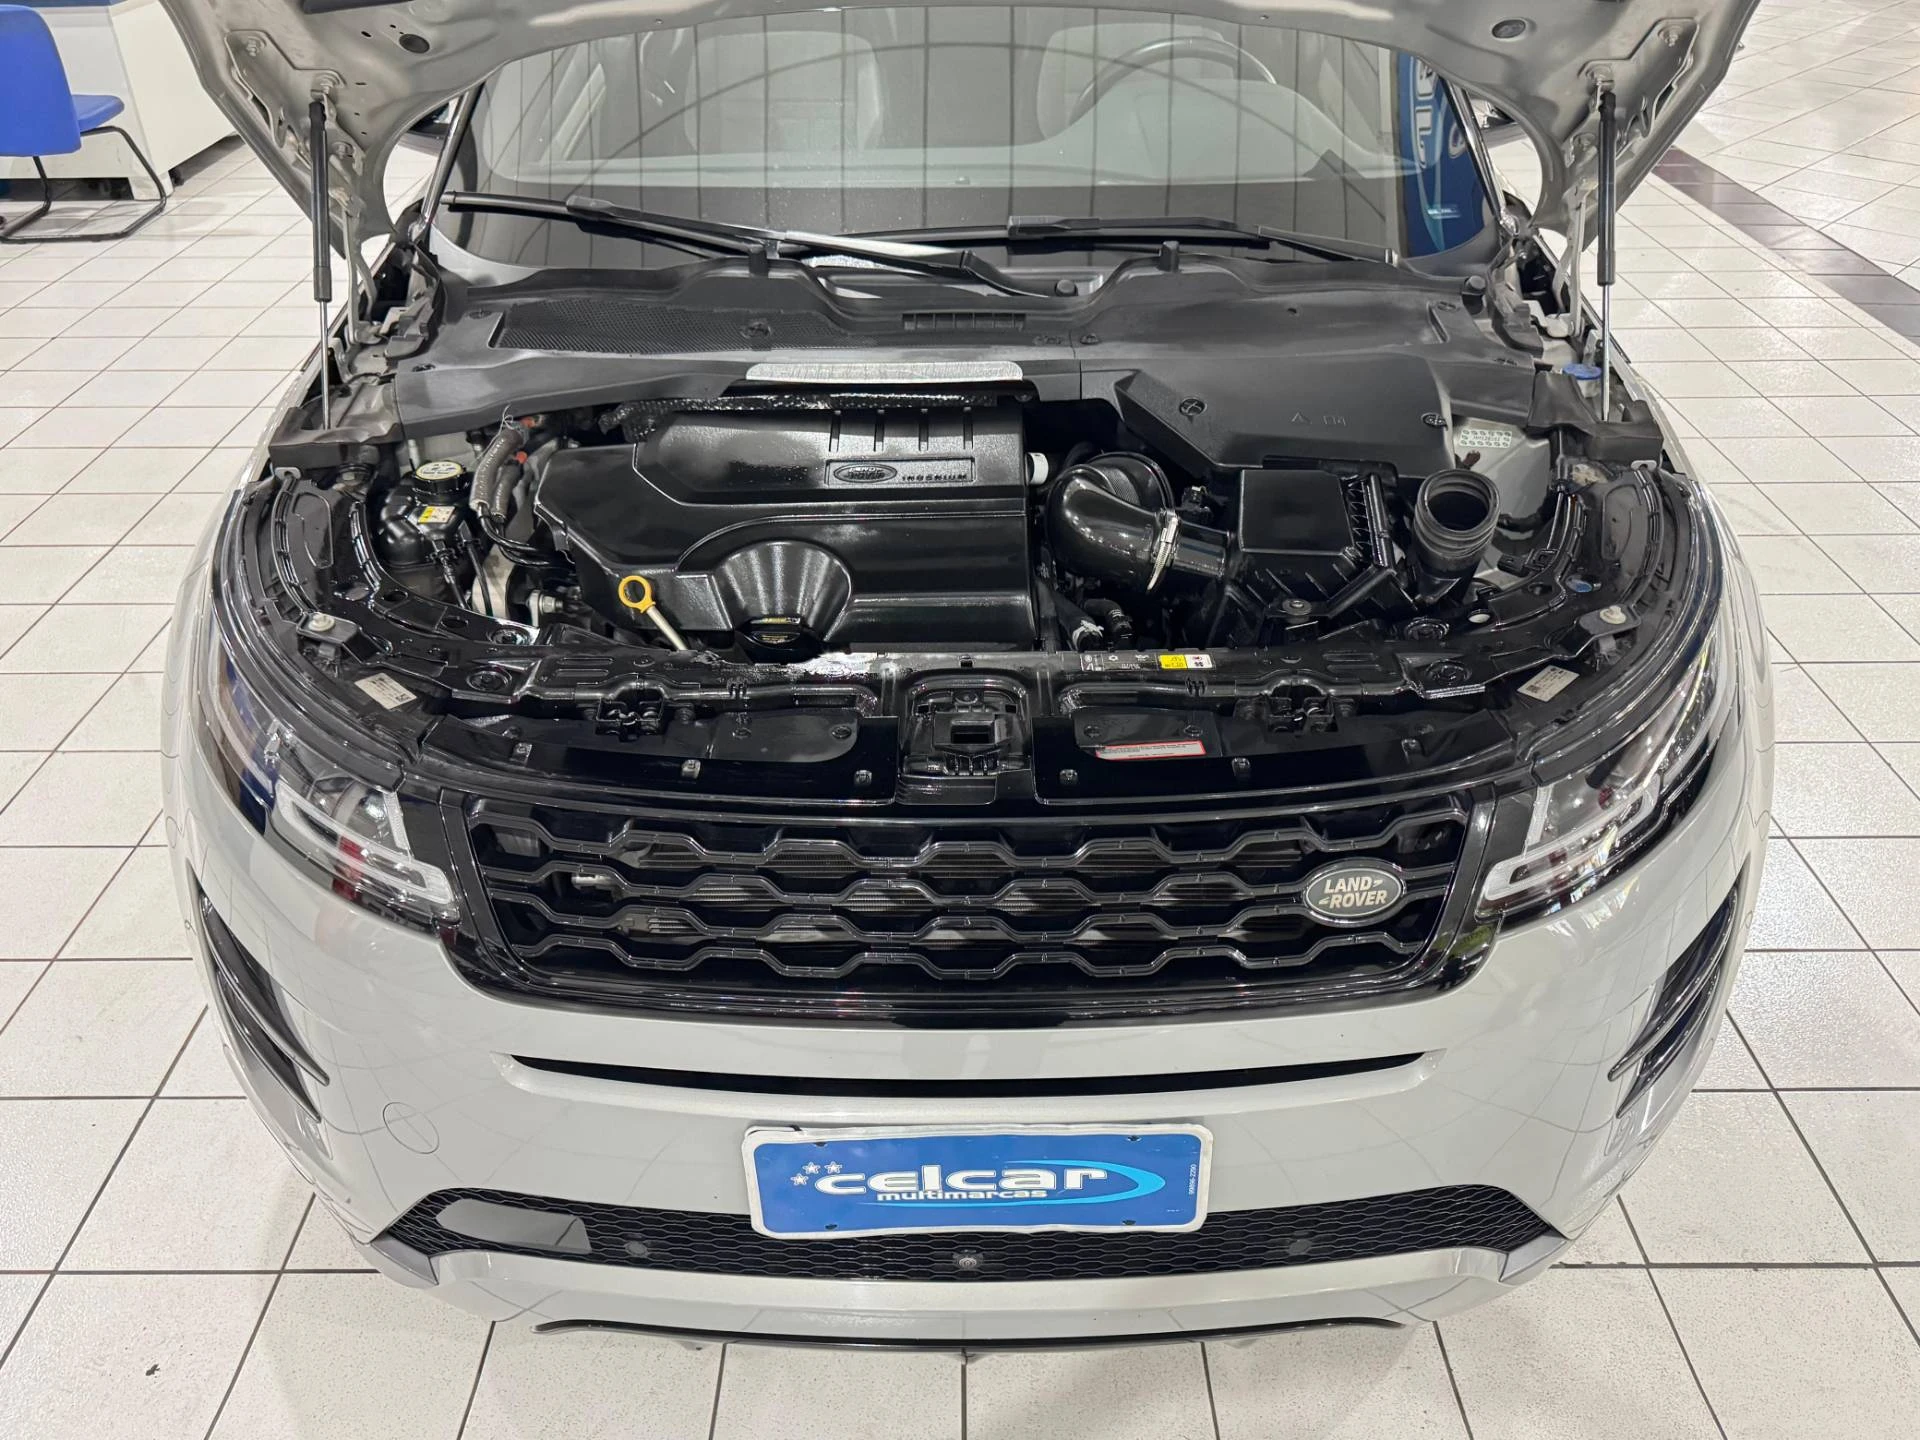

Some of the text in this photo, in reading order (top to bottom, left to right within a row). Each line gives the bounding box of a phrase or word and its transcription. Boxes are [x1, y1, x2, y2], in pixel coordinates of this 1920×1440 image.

[1325, 876, 1372, 893] LAND
[1329, 890, 1388, 909] ROVER
[814, 1165, 1108, 1195] celcar
[876, 1189, 1048, 1201] multimarcas
